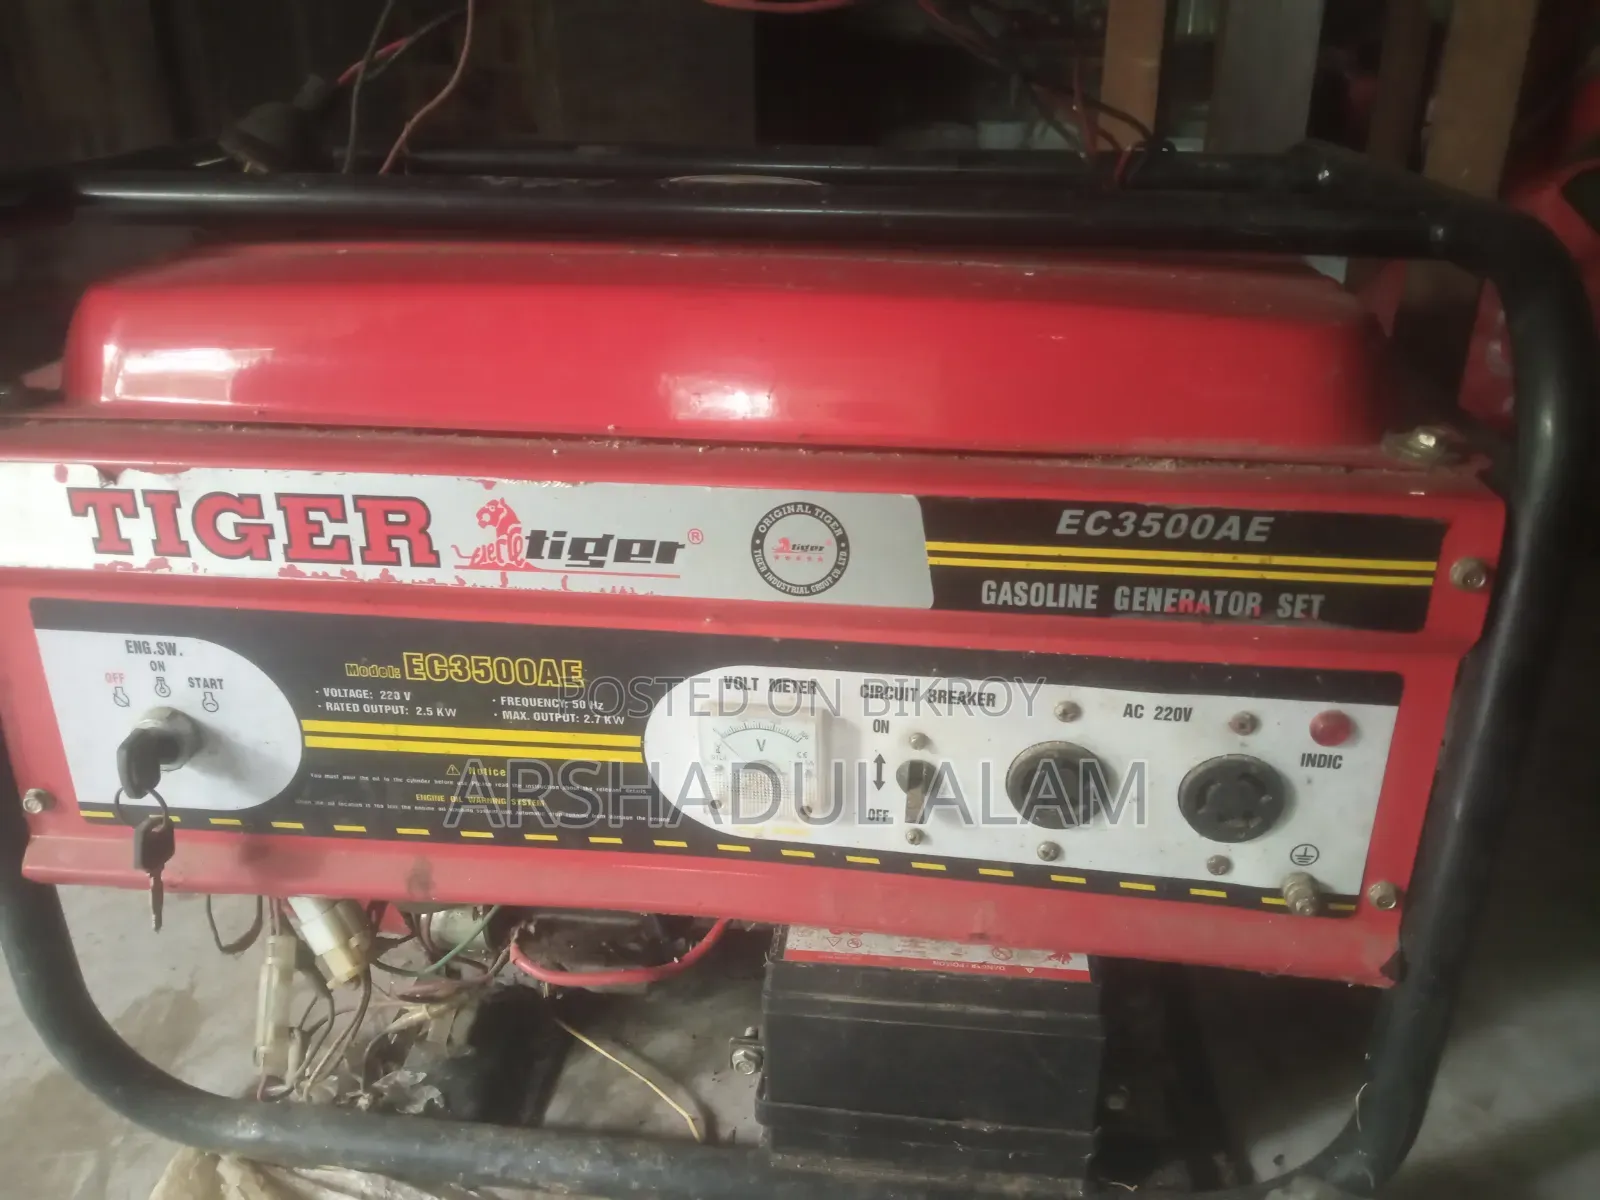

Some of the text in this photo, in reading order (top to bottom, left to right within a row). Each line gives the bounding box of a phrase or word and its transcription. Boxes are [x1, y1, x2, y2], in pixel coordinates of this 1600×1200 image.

[66, 487, 441, 568] TIGER
[758, 504, 843, 536] ORIGINAL TIGER
[1056, 509, 1275, 542] EC3500AE
[525, 529, 685, 568] tiger
[753, 549, 767, 573] TIGER
[764, 571, 810, 594] INDUSTRIAL
[810, 576, 834, 593] GROUP
[981, 579, 1326, 620] GASOLINE GENERATOR SET
[150, 660, 166, 673] ON
[345, 651, 585, 688] Model: EC3500AE
[105, 672, 125, 684] OFF
[188, 676, 224, 690] START
[724, 676, 817, 695] VOLT METER
[323, 687, 373, 700] VOLTAGE:
[403, 691, 412, 701] V
[860, 684, 996, 707] CIRCUIT BREAKER
[325, 701, 360, 713] RATED
[363, 704, 409, 716] OUTPUT:
[415, 706, 434, 717] 2.5
[501, 696, 604, 711] FREQUENCY: 50 Hz
[502, 710, 530, 721] MAX.
[534, 712, 580, 723] OUTPUT:
[584, 714, 601, 724] 2.7
[1122, 703, 1193, 723] AC 220V
[873, 719, 890, 734] ON
[756, 738, 767, 752] V
[1300, 753, 1343, 770] INDIC
[468, 766, 507, 777] Notice
[415, 793, 546, 807] ENGINE OIL WARNING SYSTEM
[868, 808, 889, 822] OFF
